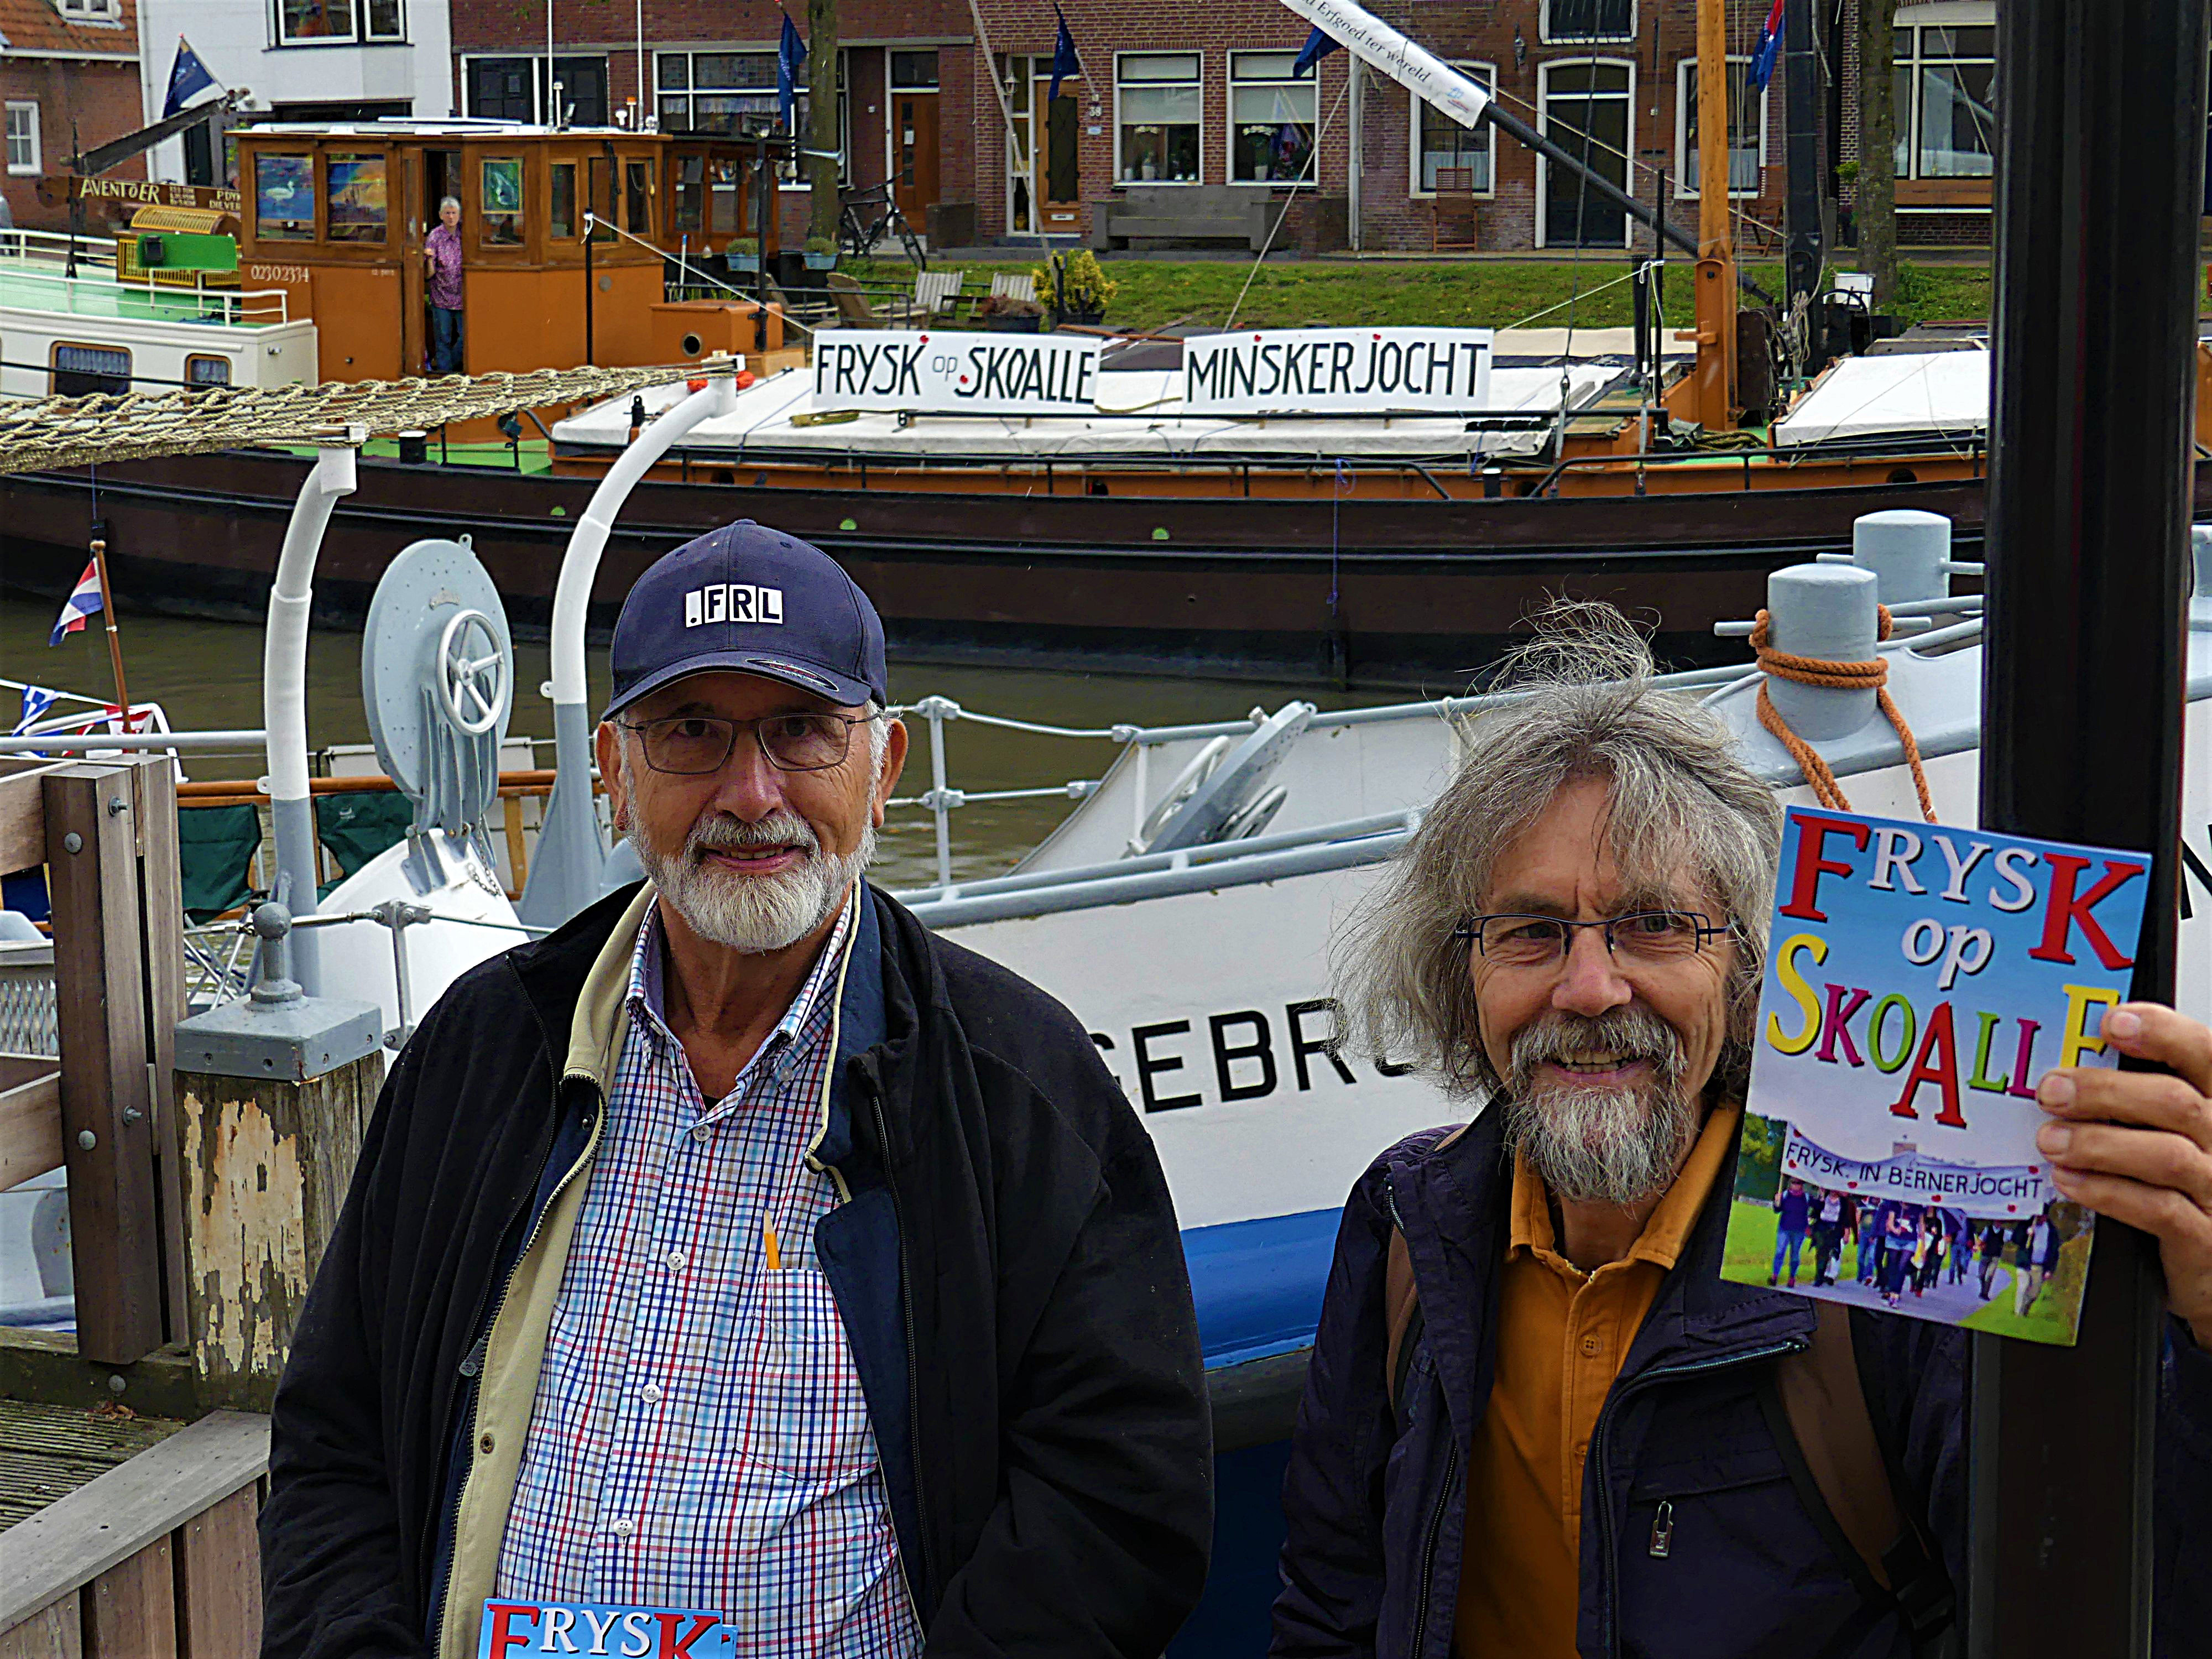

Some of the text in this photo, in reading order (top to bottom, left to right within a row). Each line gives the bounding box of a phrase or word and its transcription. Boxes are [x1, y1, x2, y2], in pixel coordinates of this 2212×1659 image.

[1316, 1, 1432, 82] Erfgoed ter wereld
[251, 265, 310, 283] 02302334
[816, 343, 1095, 405] FRYSK op SKOALLE
[1187, 341, 1489, 403] MINSKERJOCHT
[1778, 813, 2145, 970] FRYSK
[1902, 917, 1994, 990] op
[1859, 1164, 1881, 1182] IN
[1888, 1166, 2043, 1198] BERNERJOCHT
[487, 1604, 720, 1659] FRYSK
